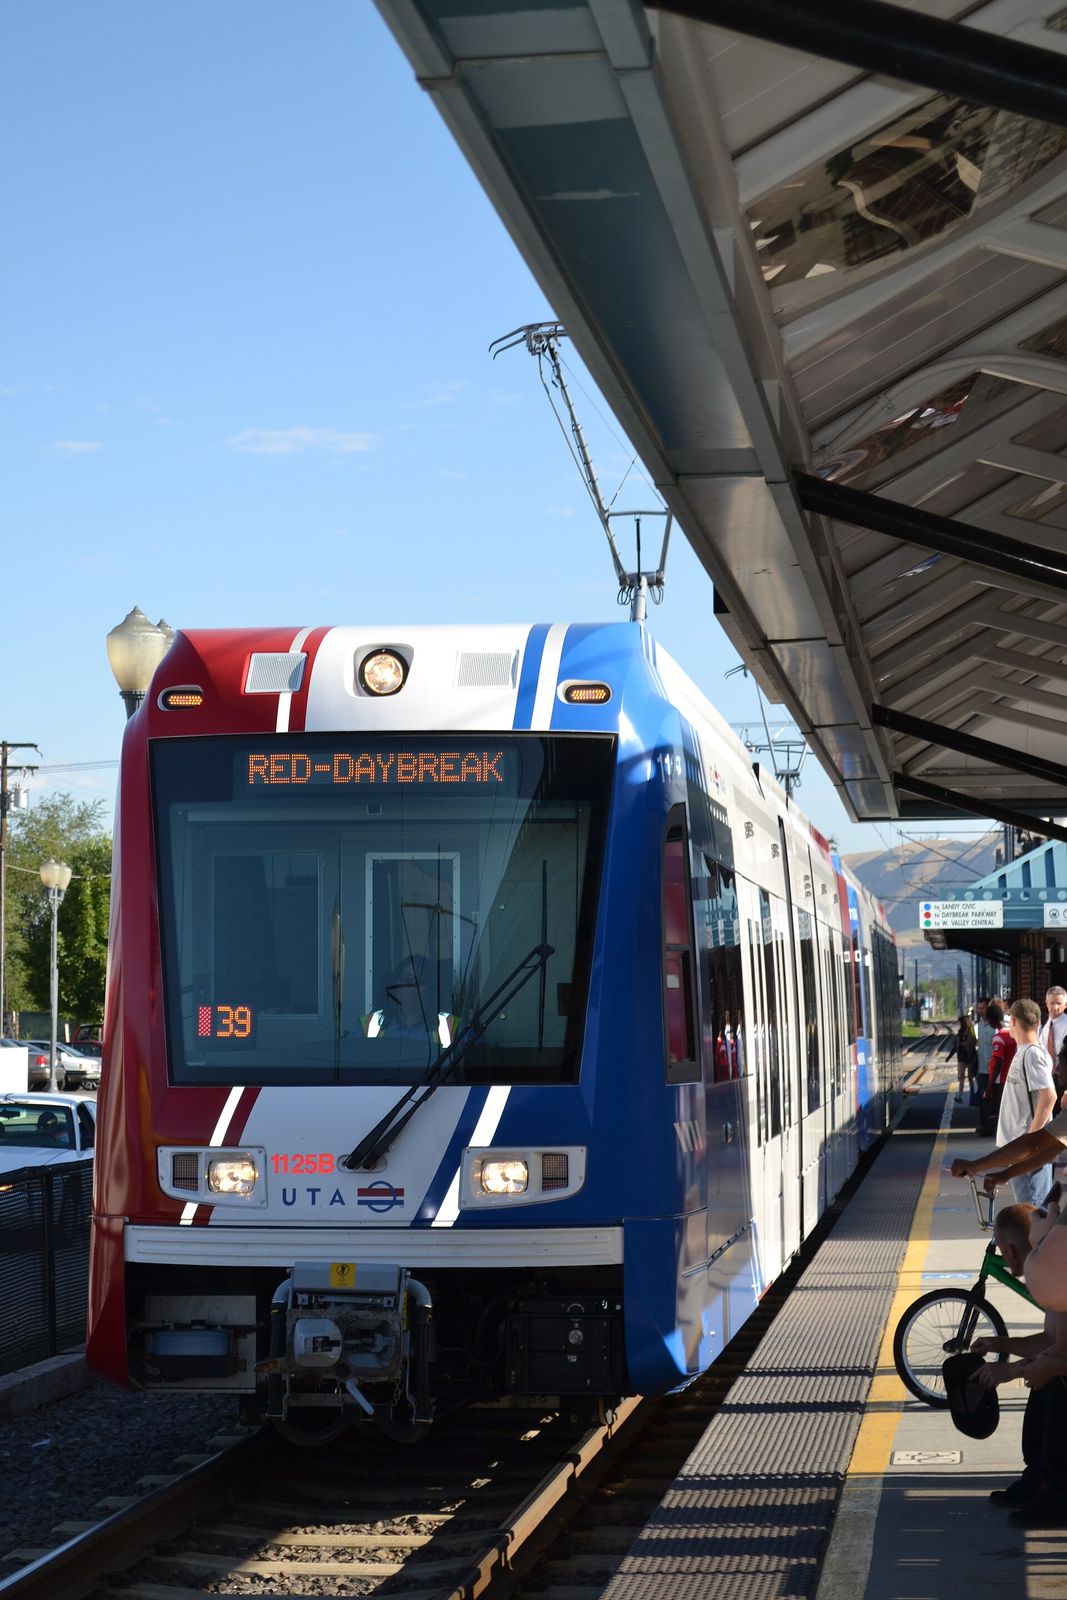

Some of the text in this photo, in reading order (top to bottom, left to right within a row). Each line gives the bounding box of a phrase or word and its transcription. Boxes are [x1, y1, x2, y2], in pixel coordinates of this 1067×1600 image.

[248, 752, 503, 784] RED-DAYBREAK
[216, 1006, 251, 1037] 39
[271, 1153, 335, 1175] 1125B
[282, 1187, 346, 1206] UTA
